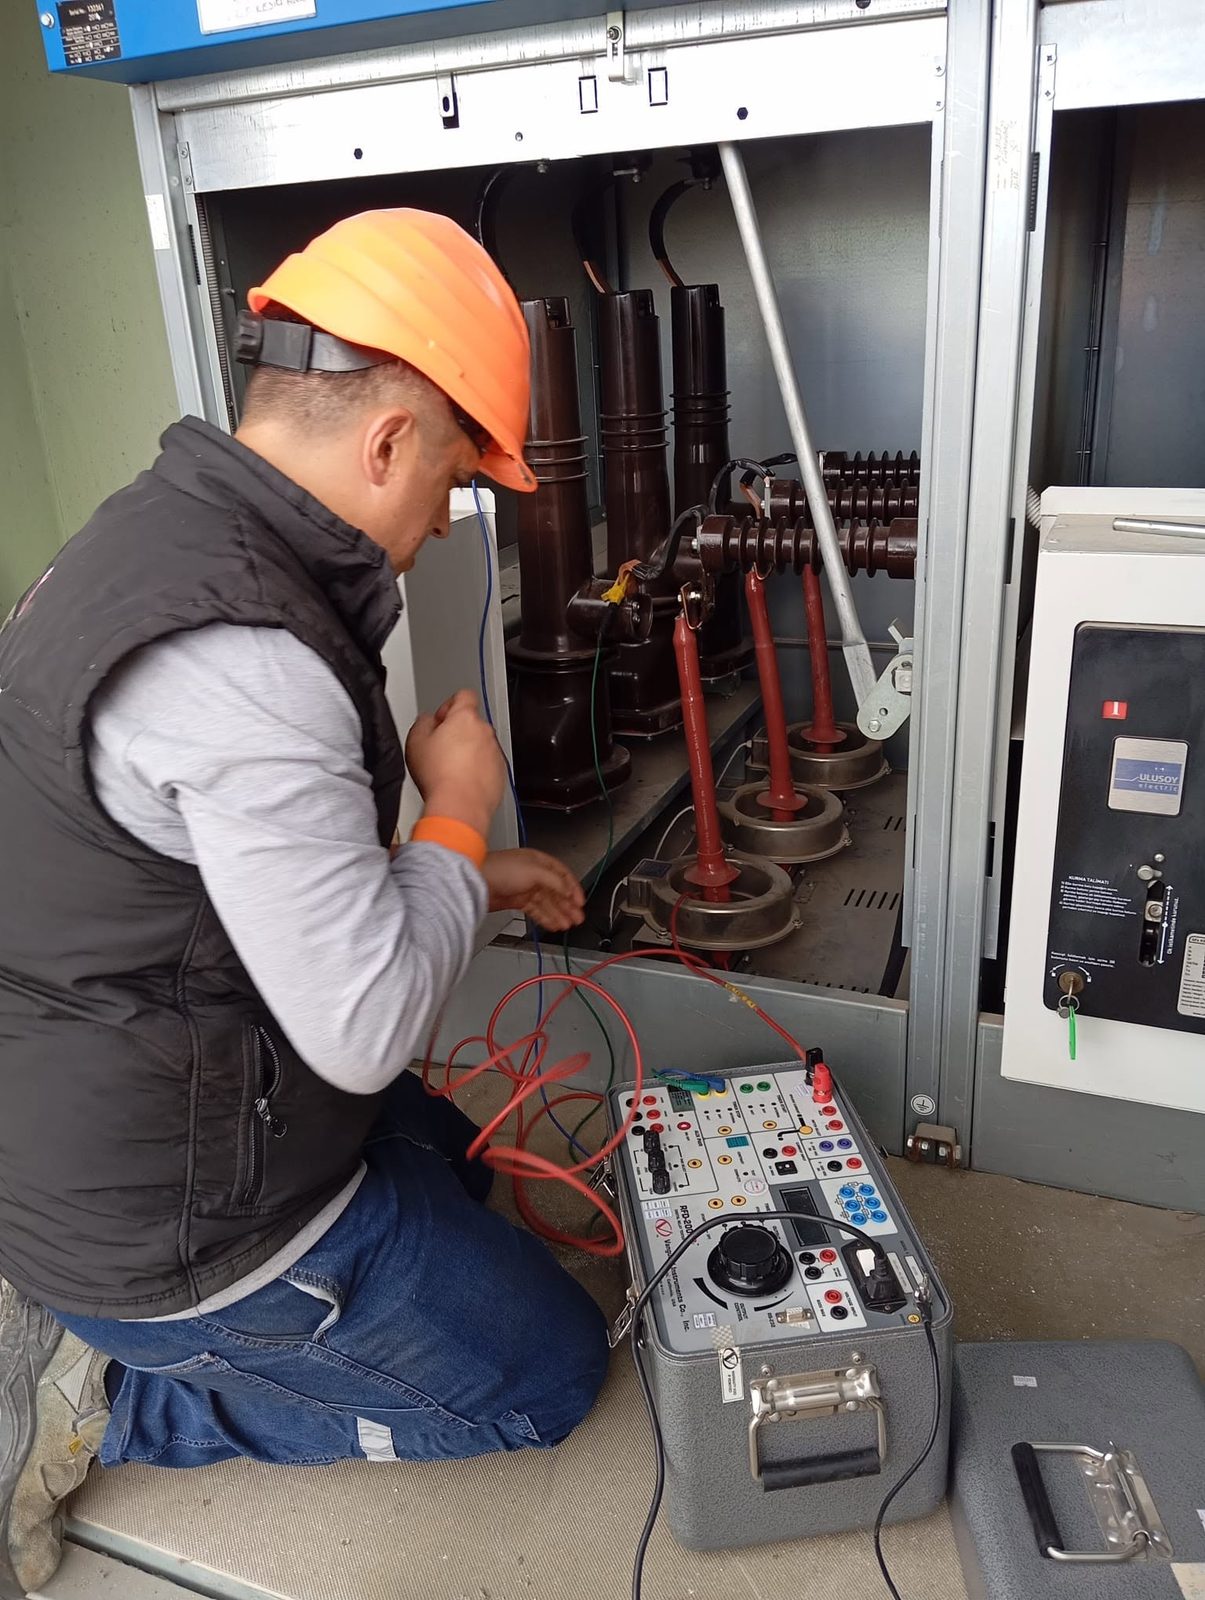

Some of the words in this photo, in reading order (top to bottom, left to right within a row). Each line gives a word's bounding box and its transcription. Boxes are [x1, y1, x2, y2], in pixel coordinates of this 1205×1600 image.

[1140, 773, 1178, 783] ULUSOY
[1138, 784, 1178, 792] electric
[670, 1266, 684, 1302] Instruments
[677, 1303, 688, 1317] Co.,
[733, 1302, 743, 1321] CONTROL
[739, 1302, 748, 1319] OUTPUT
[682, 1320, 691, 1332] Inc.
